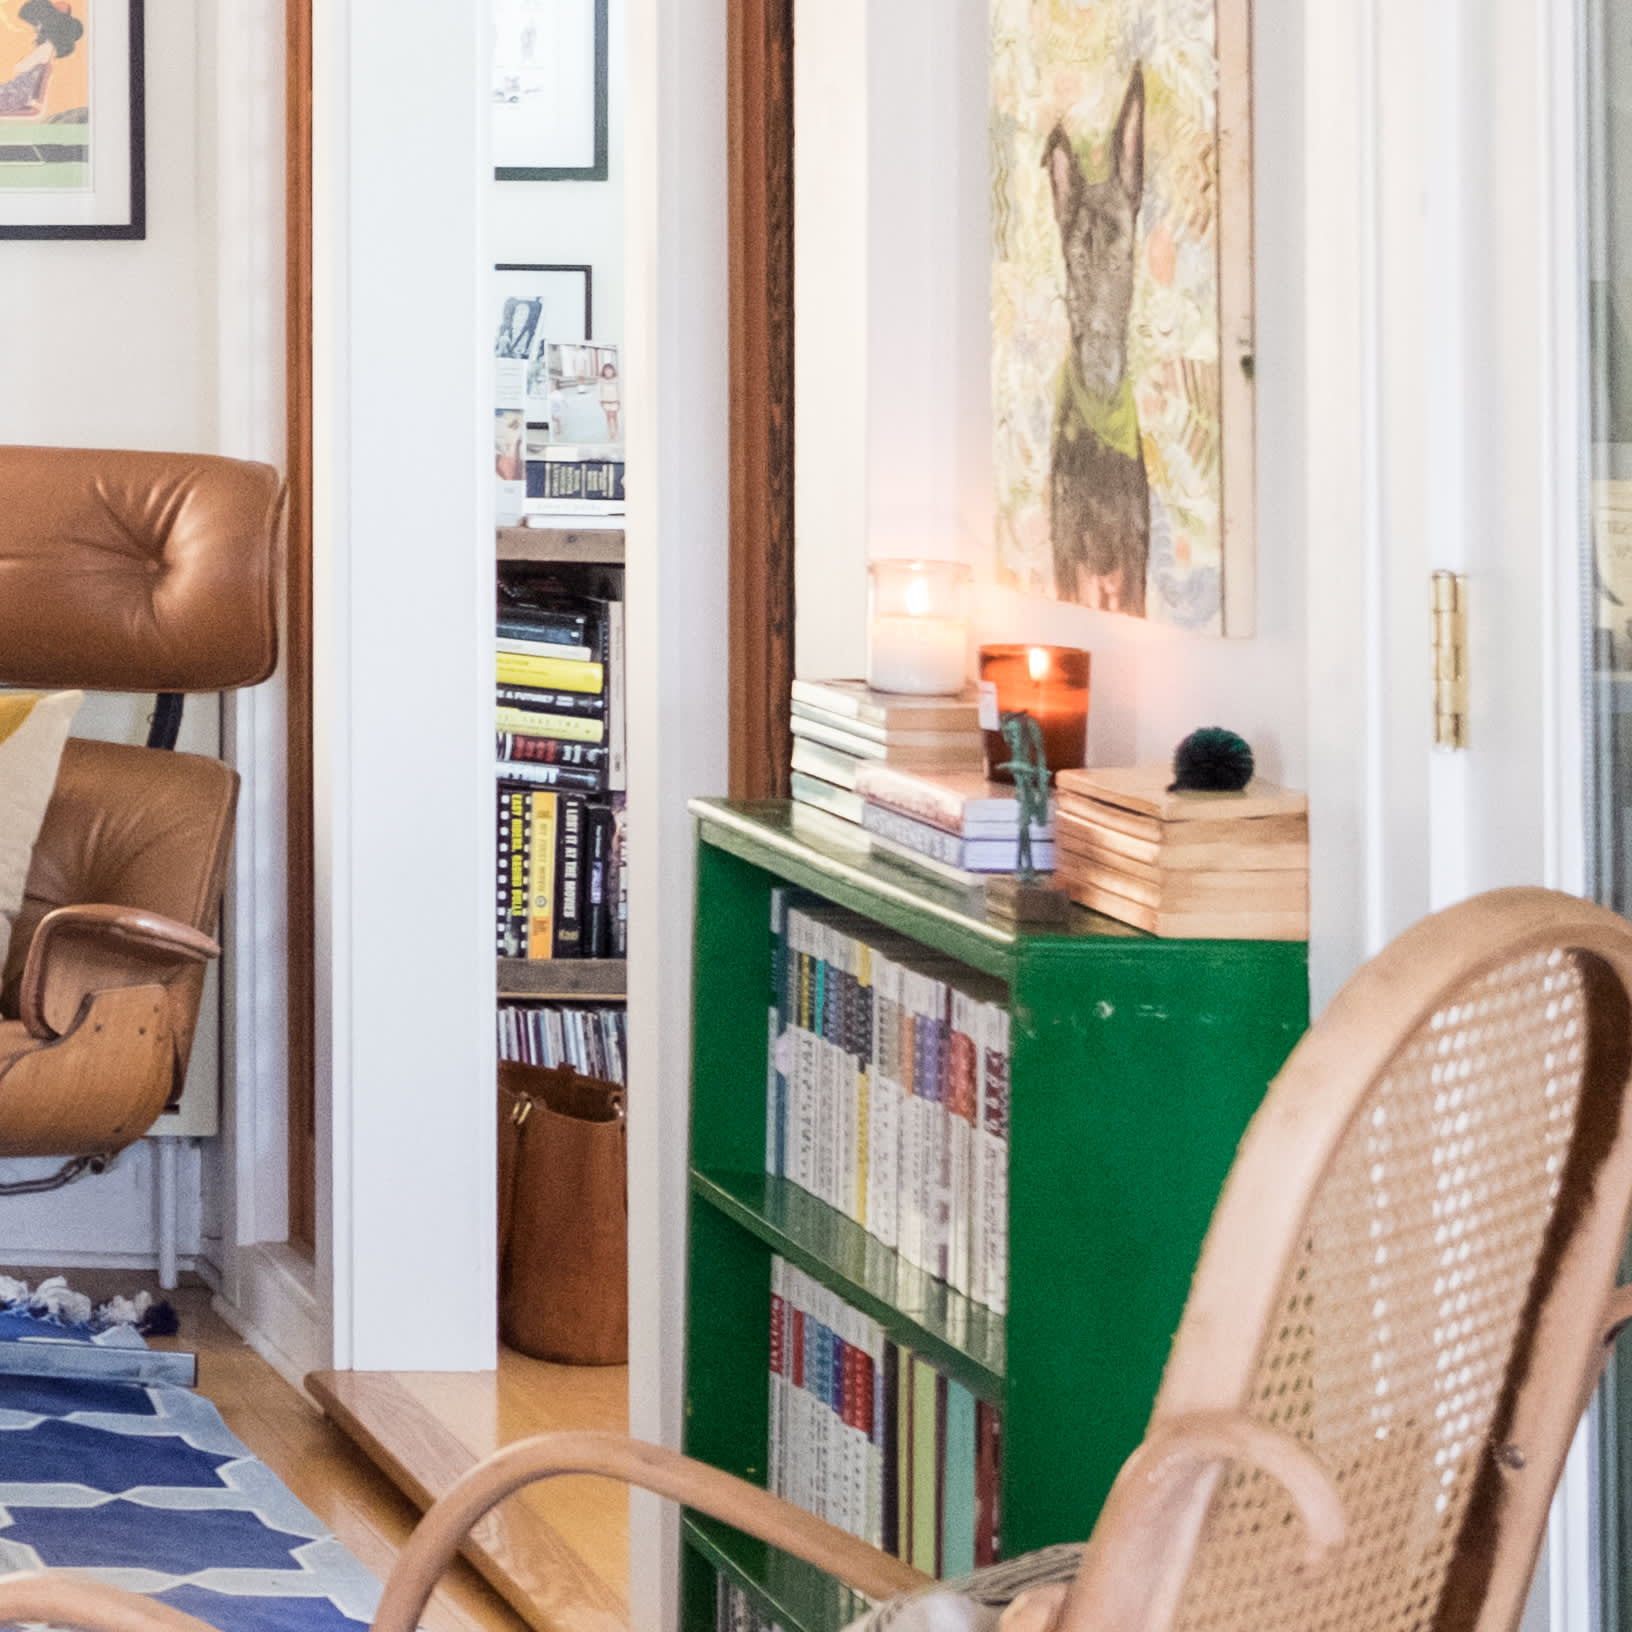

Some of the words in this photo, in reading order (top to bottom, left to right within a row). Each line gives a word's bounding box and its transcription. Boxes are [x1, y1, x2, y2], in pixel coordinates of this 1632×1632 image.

[565, 809, 579, 832] LOST
[565, 835, 578, 845] IT
[564, 847, 578, 859] AT
[564, 861, 578, 879] THE
[563, 880, 577, 920] MOVIES
